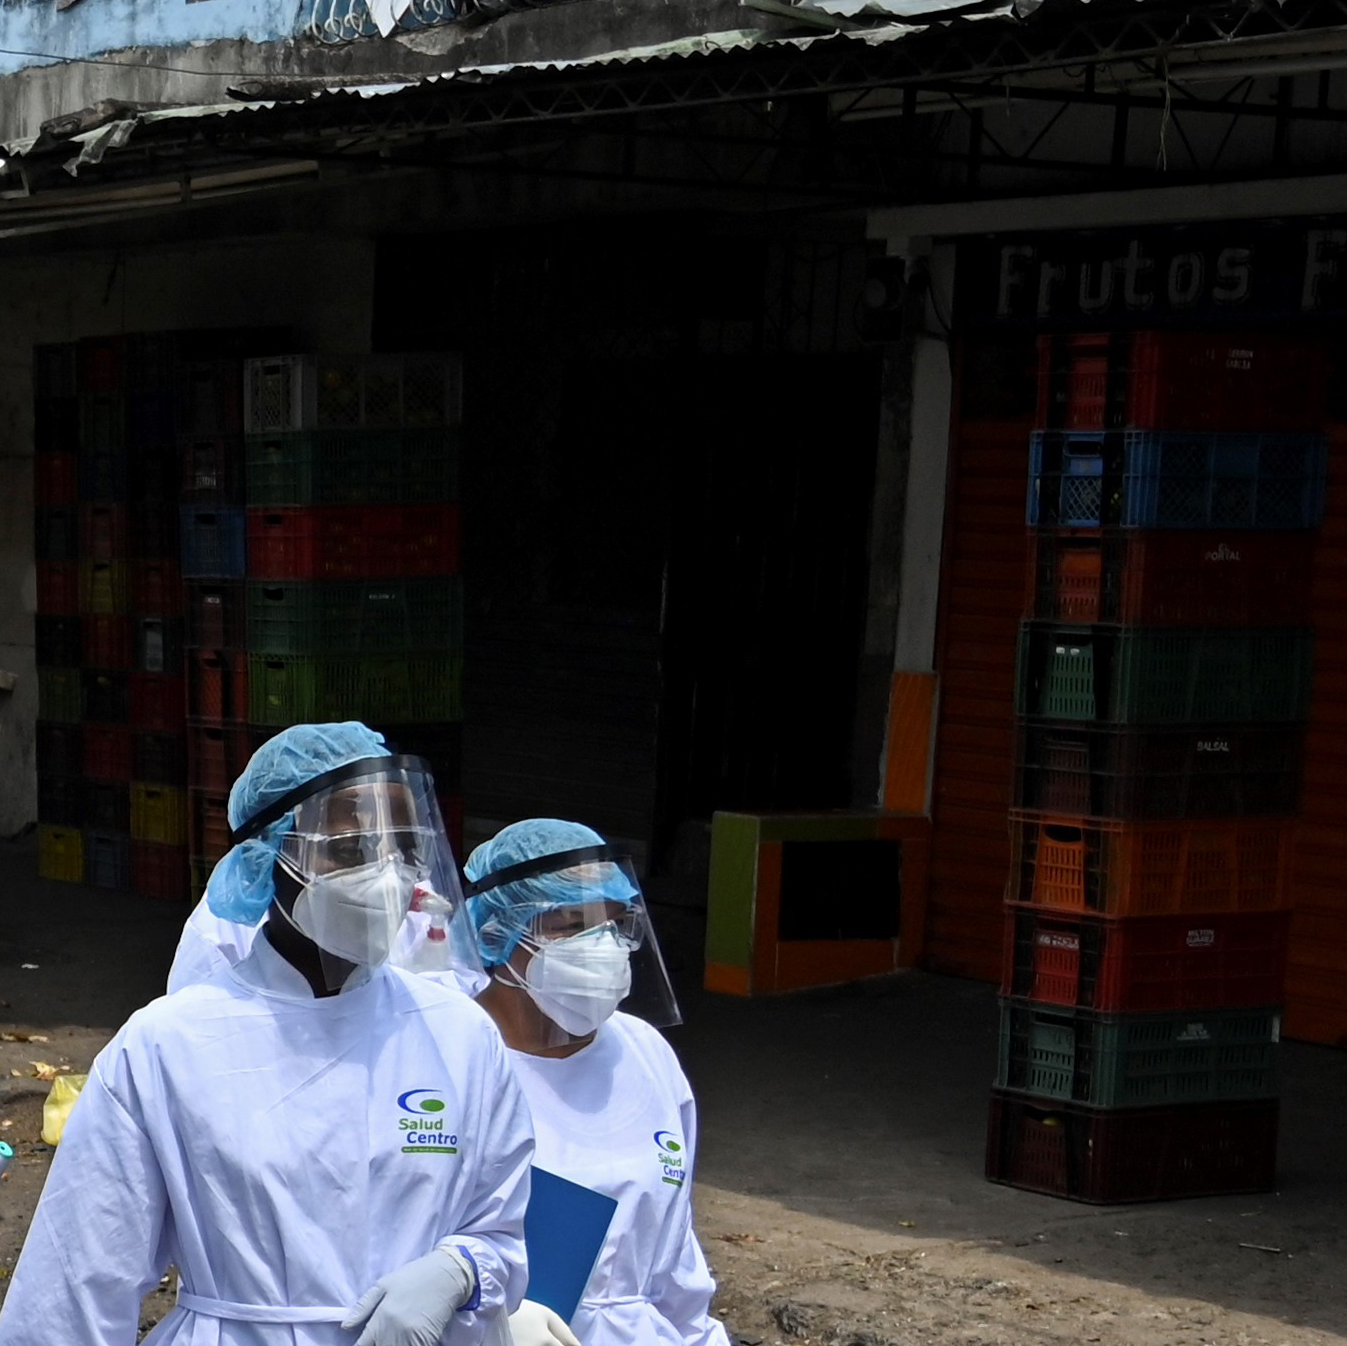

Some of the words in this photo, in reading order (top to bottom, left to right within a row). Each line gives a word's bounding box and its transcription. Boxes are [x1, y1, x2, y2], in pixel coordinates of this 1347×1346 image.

[997, 238, 1256, 320] Frutos
[397, 1118, 444, 1131] Salud
[406, 1131, 458, 1146] Centro
